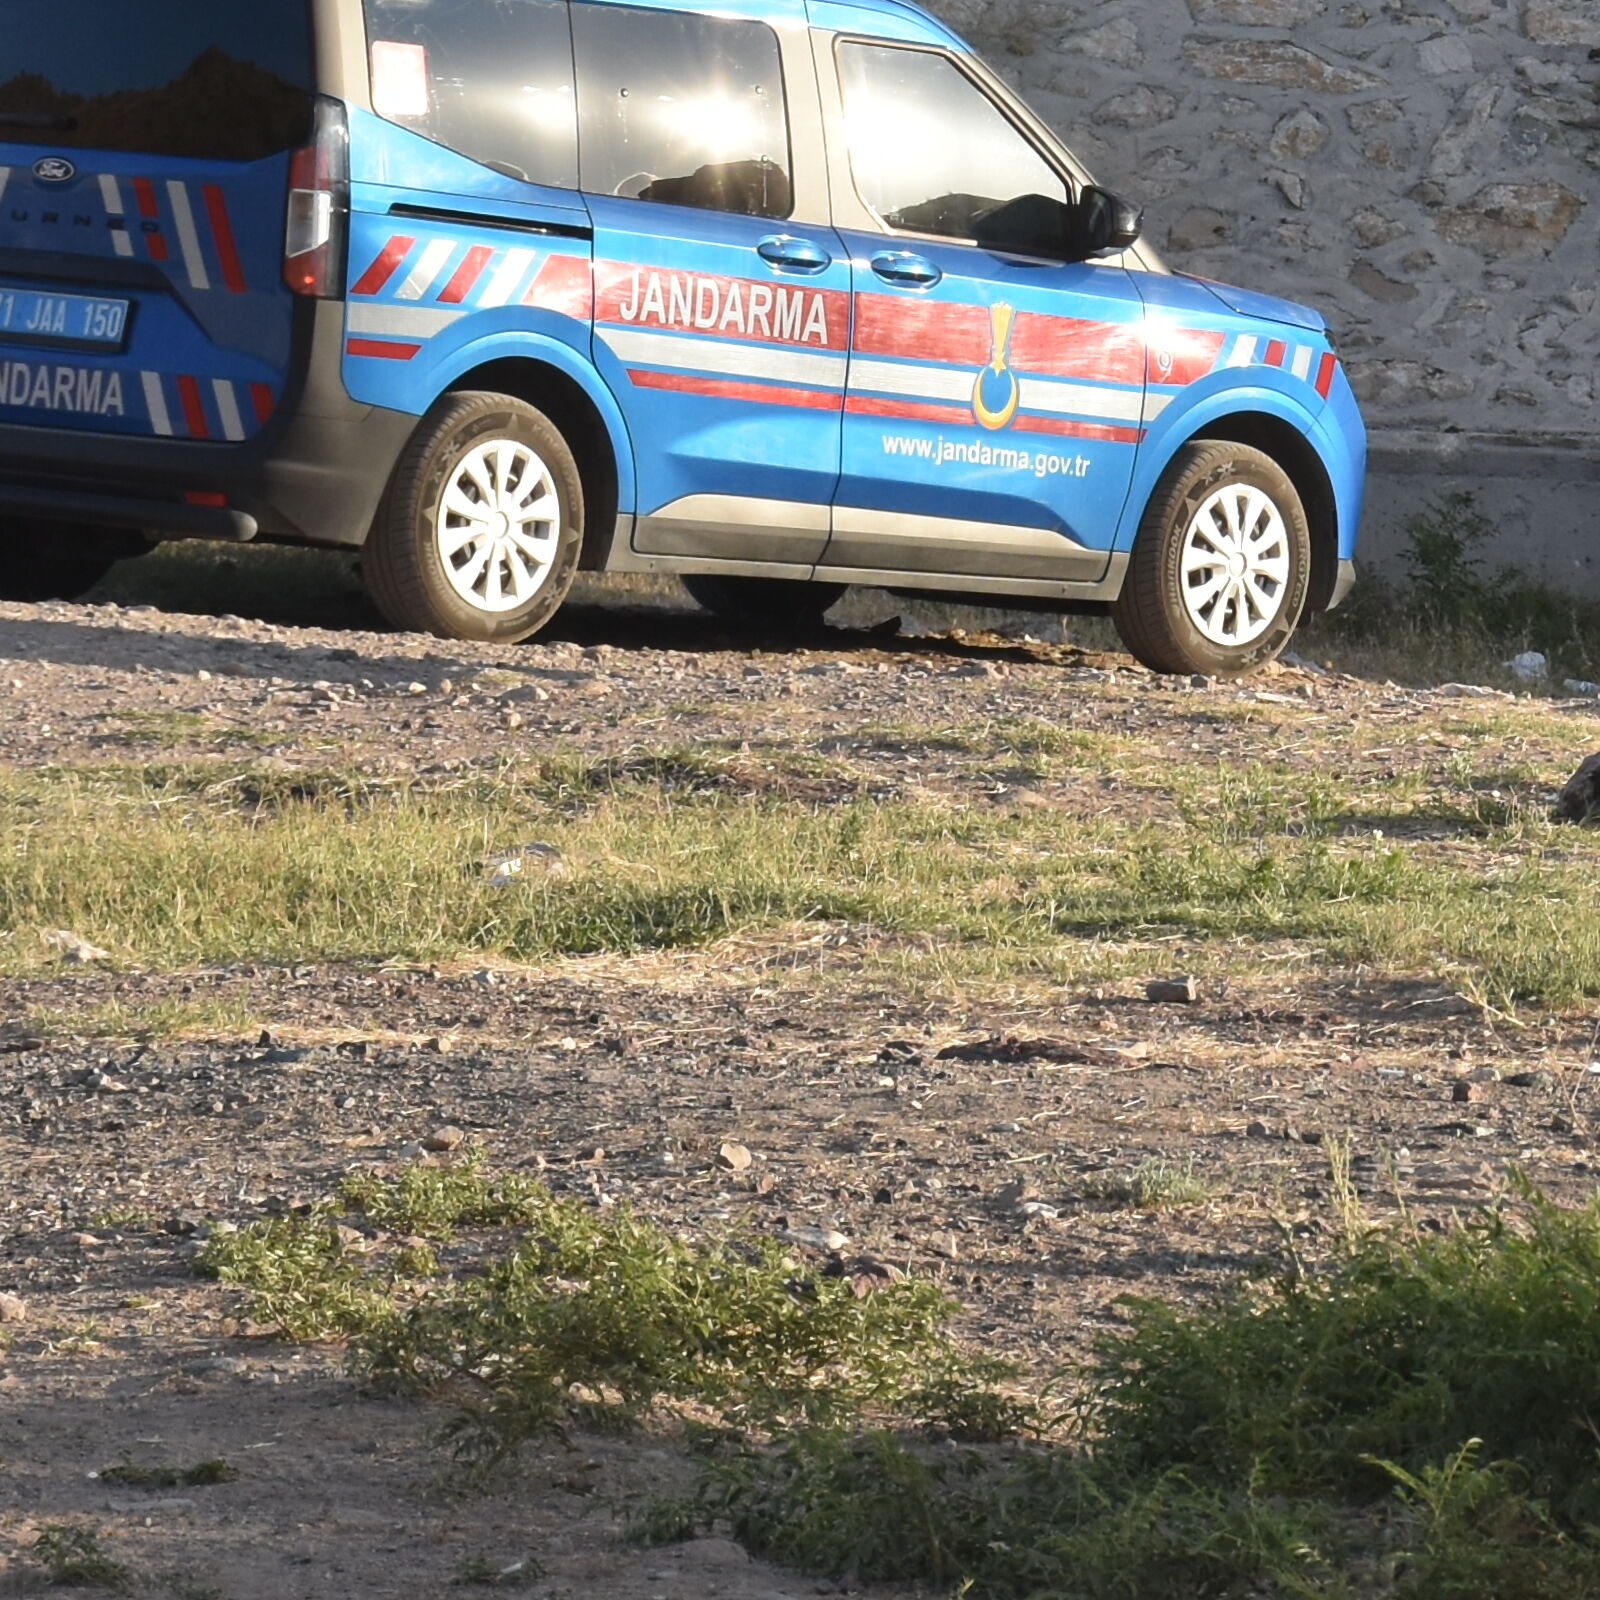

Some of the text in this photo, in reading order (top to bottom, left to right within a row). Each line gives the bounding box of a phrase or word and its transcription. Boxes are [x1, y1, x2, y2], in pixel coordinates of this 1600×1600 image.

[26, 297, 67, 333] JAA
[84, 303, 122, 338] 150
[619, 269, 828, 345] JANDARMA
[882, 434, 1091, 478] www.jandarma.gov.tr
